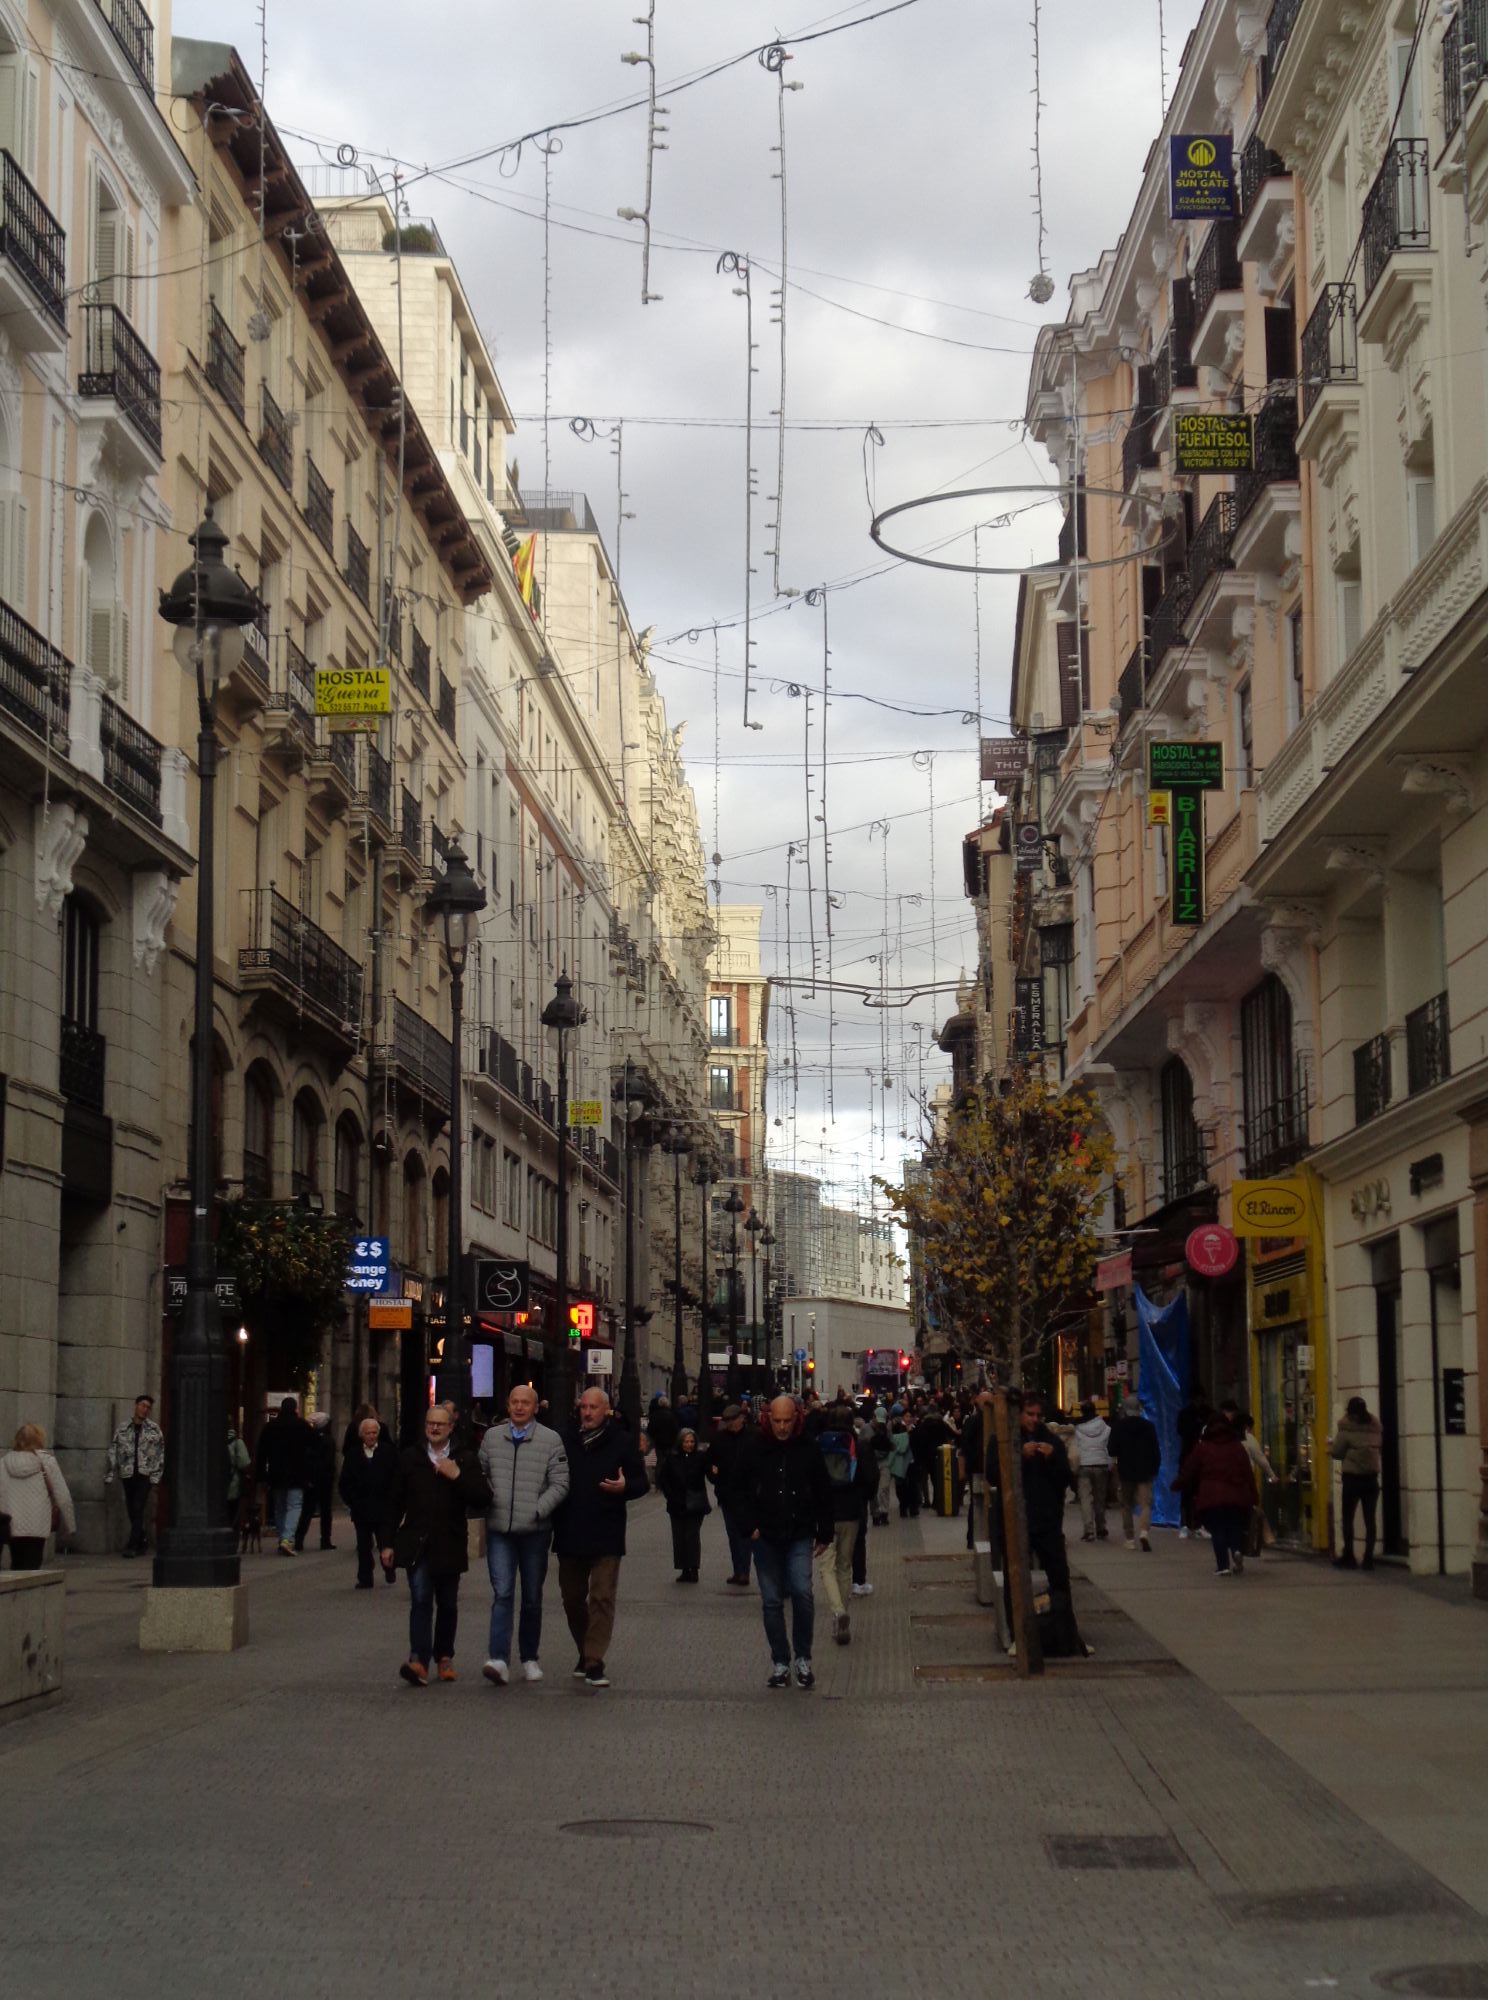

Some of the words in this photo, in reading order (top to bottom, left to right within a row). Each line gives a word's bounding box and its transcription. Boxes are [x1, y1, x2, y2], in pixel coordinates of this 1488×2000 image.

[1179, 169, 1225, 178] HOSTAL
[1175, 179, 1198, 188] SUN
[1200, 179, 1230, 188] GATE
[1179, 416, 1228, 432] HOSTAL
[1178, 432, 1251, 448] FUENTESOL
[318, 671, 386, 686] HOSTAL
[323, 686, 380, 704] Guerra
[1152, 745, 1196, 760] HOSTAL
[995, 761, 1022, 769] THC
[1177, 796, 1197, 919] BIARRITZ
[1247, 1200, 1258, 1216] El
